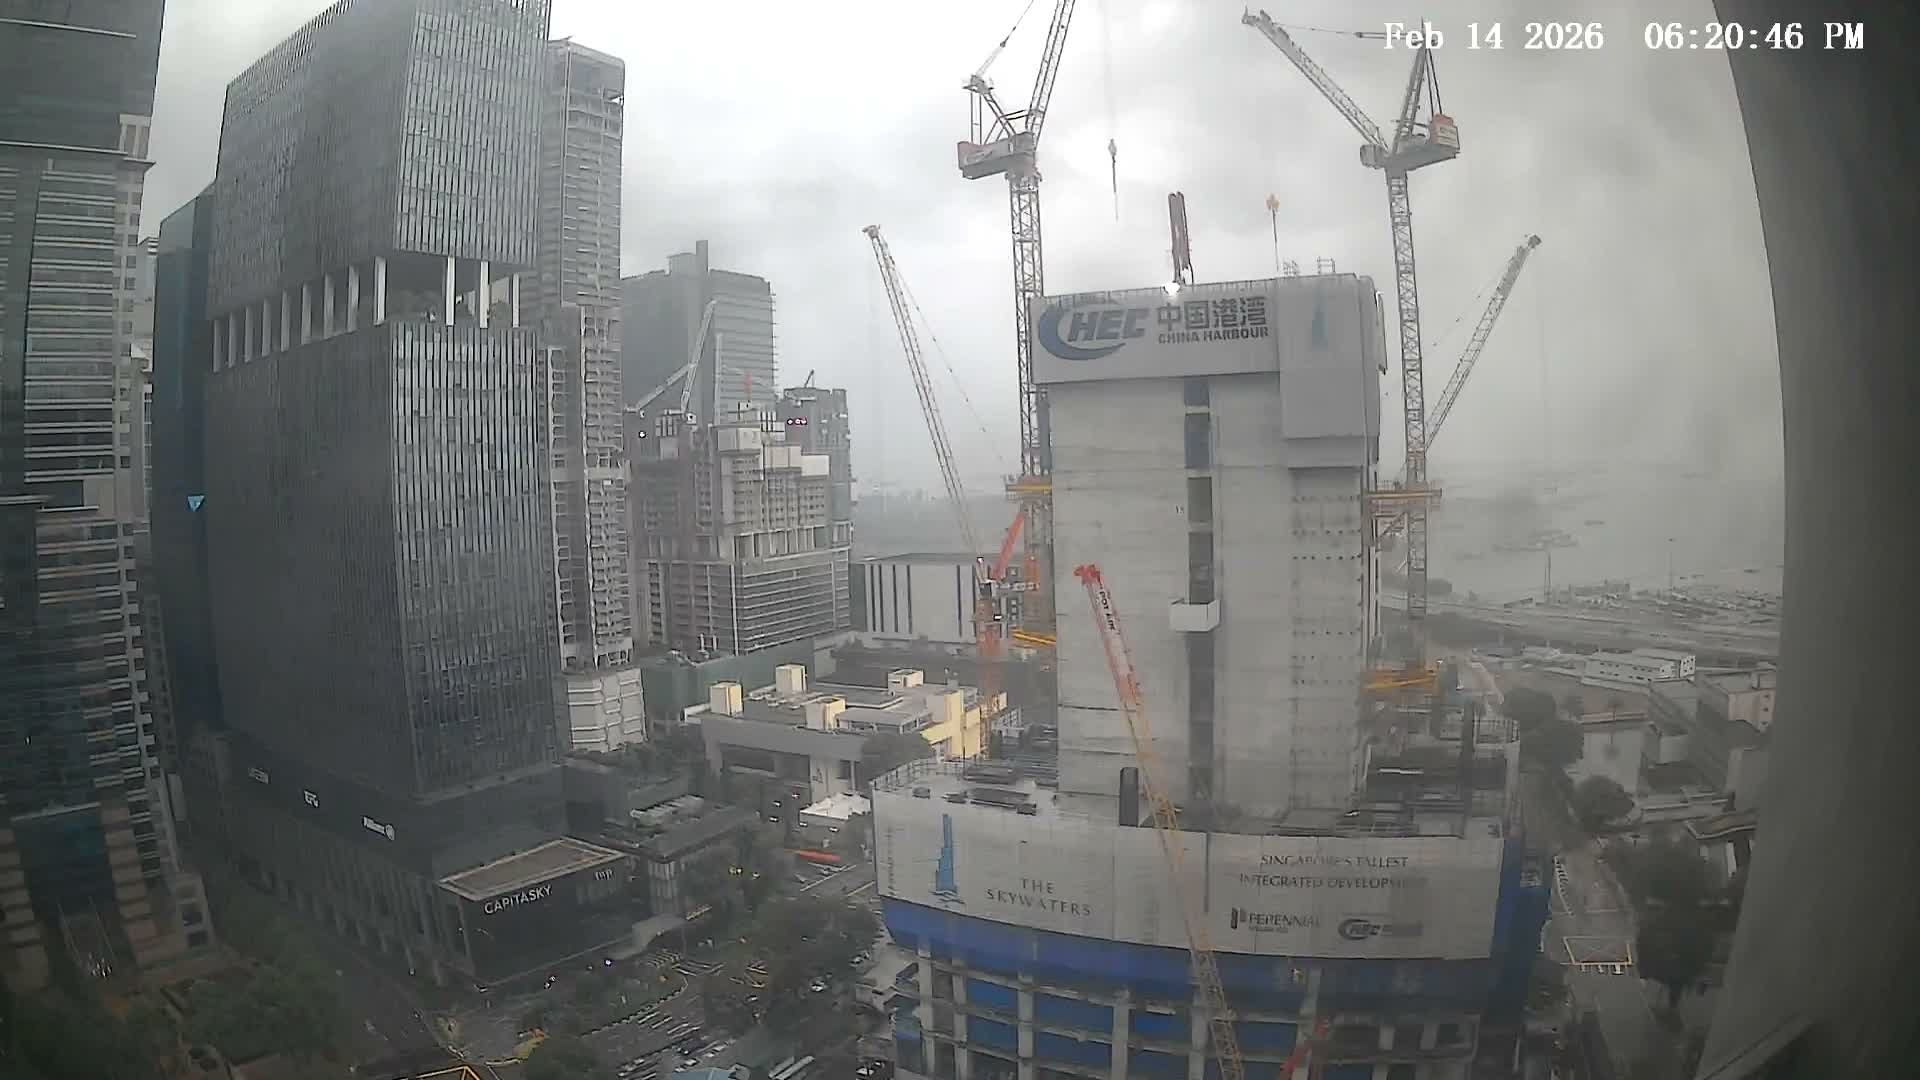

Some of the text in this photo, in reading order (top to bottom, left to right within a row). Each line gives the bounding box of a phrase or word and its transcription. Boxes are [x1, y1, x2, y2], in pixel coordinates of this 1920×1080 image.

[1156, 296, 1268, 331] 中国港湾
[1158, 326, 1270, 345] CHINA HARBOUR
[1020, 877, 1055, 895] THE
[1240, 872, 1427, 889] INTEGRATED DEVELOP
[484, 884, 552, 915] CAPITASKY
[986, 888, 1091, 916] SKYWATERS
